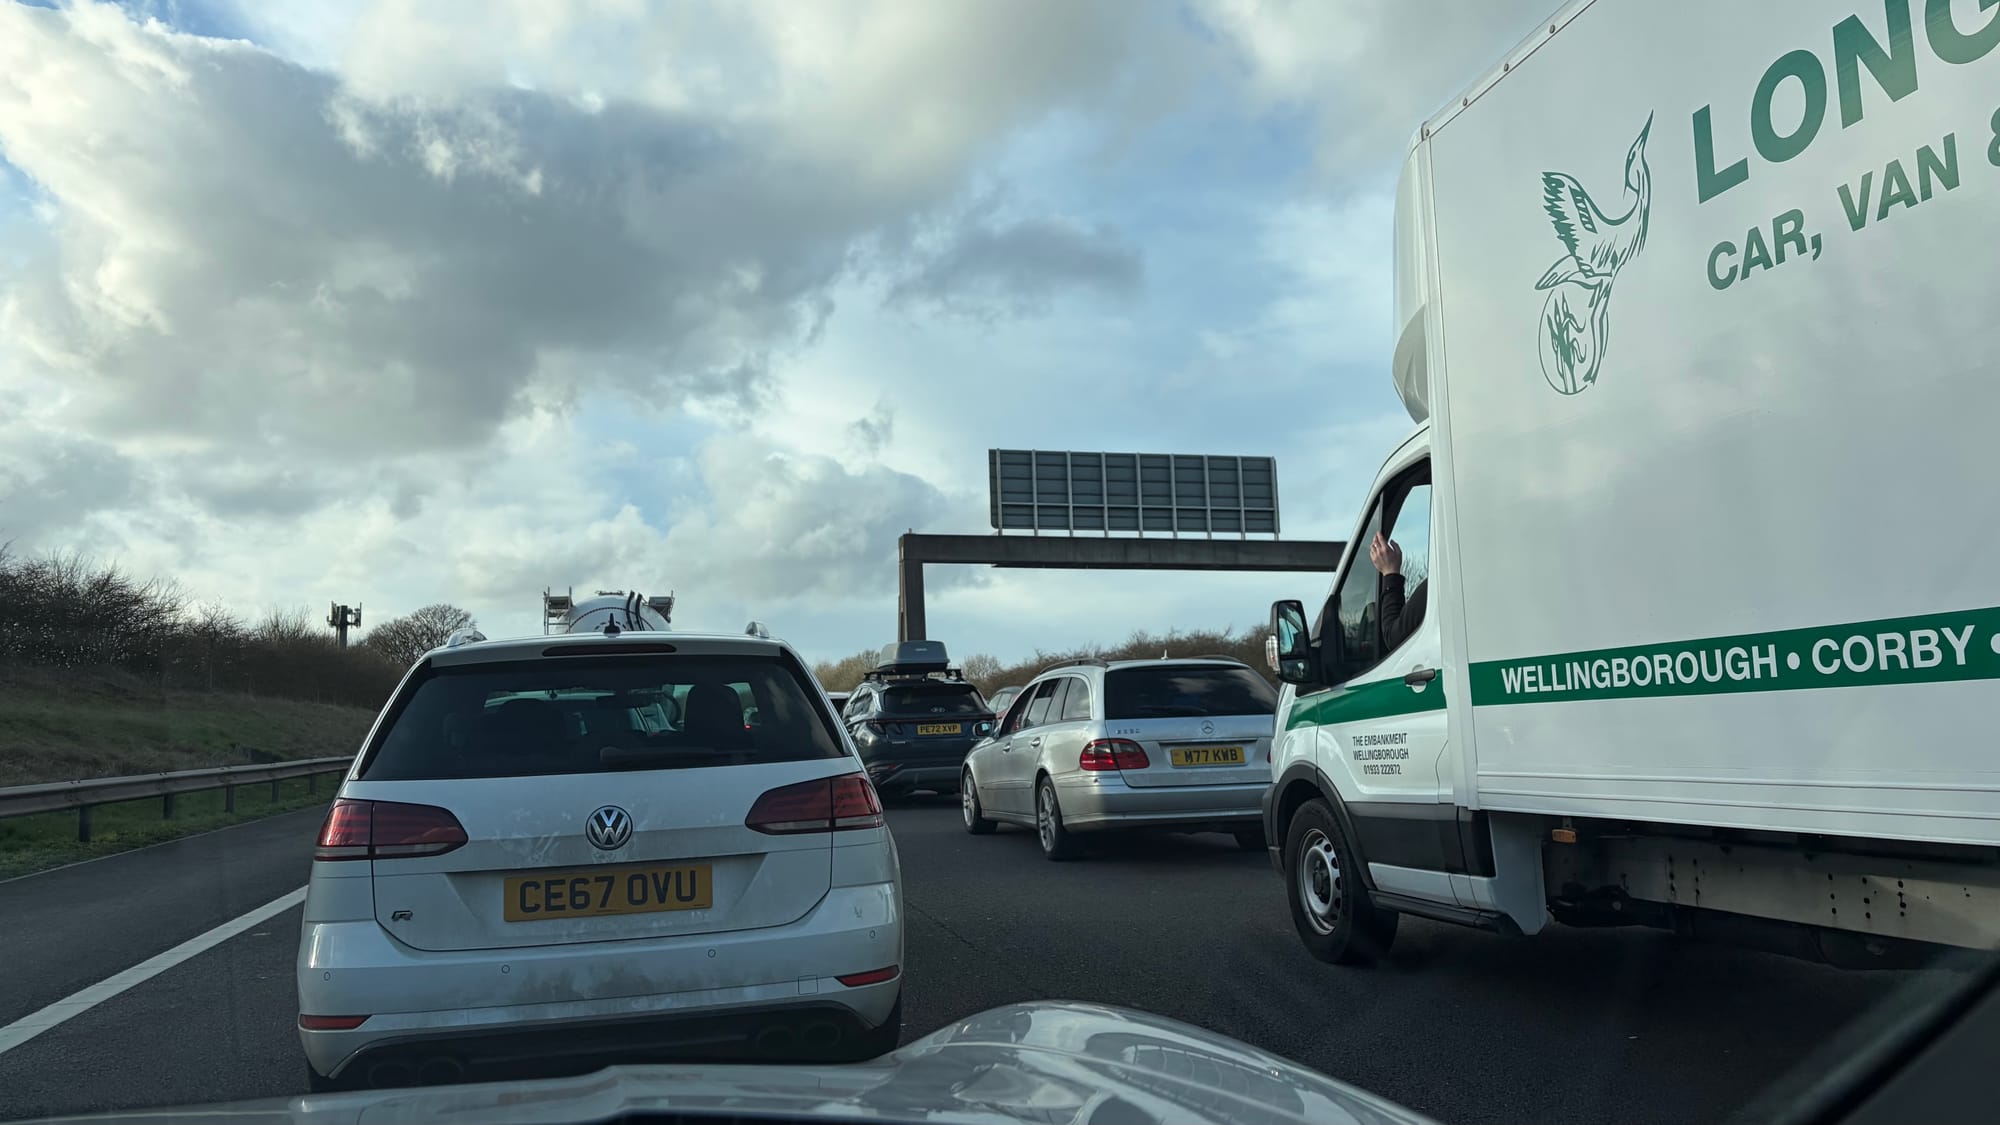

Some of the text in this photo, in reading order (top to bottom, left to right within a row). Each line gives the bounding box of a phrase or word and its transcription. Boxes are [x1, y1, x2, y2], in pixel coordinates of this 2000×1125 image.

[1707, 209, 1822, 290] CAR,
[1837, 132, 1960, 232] VAN
[1501, 625, 1975, 693] WELLINGBOROUGH CORBY
[1352, 733, 1407, 746] THE EMBANKMENT
[1184, 748, 1238, 762] M77 KWB
[1353, 748, 1409, 760] WELLINGBOROUGH
[1363, 764, 1380, 775] 01933
[520, 870, 696, 913] CE67 OVU
